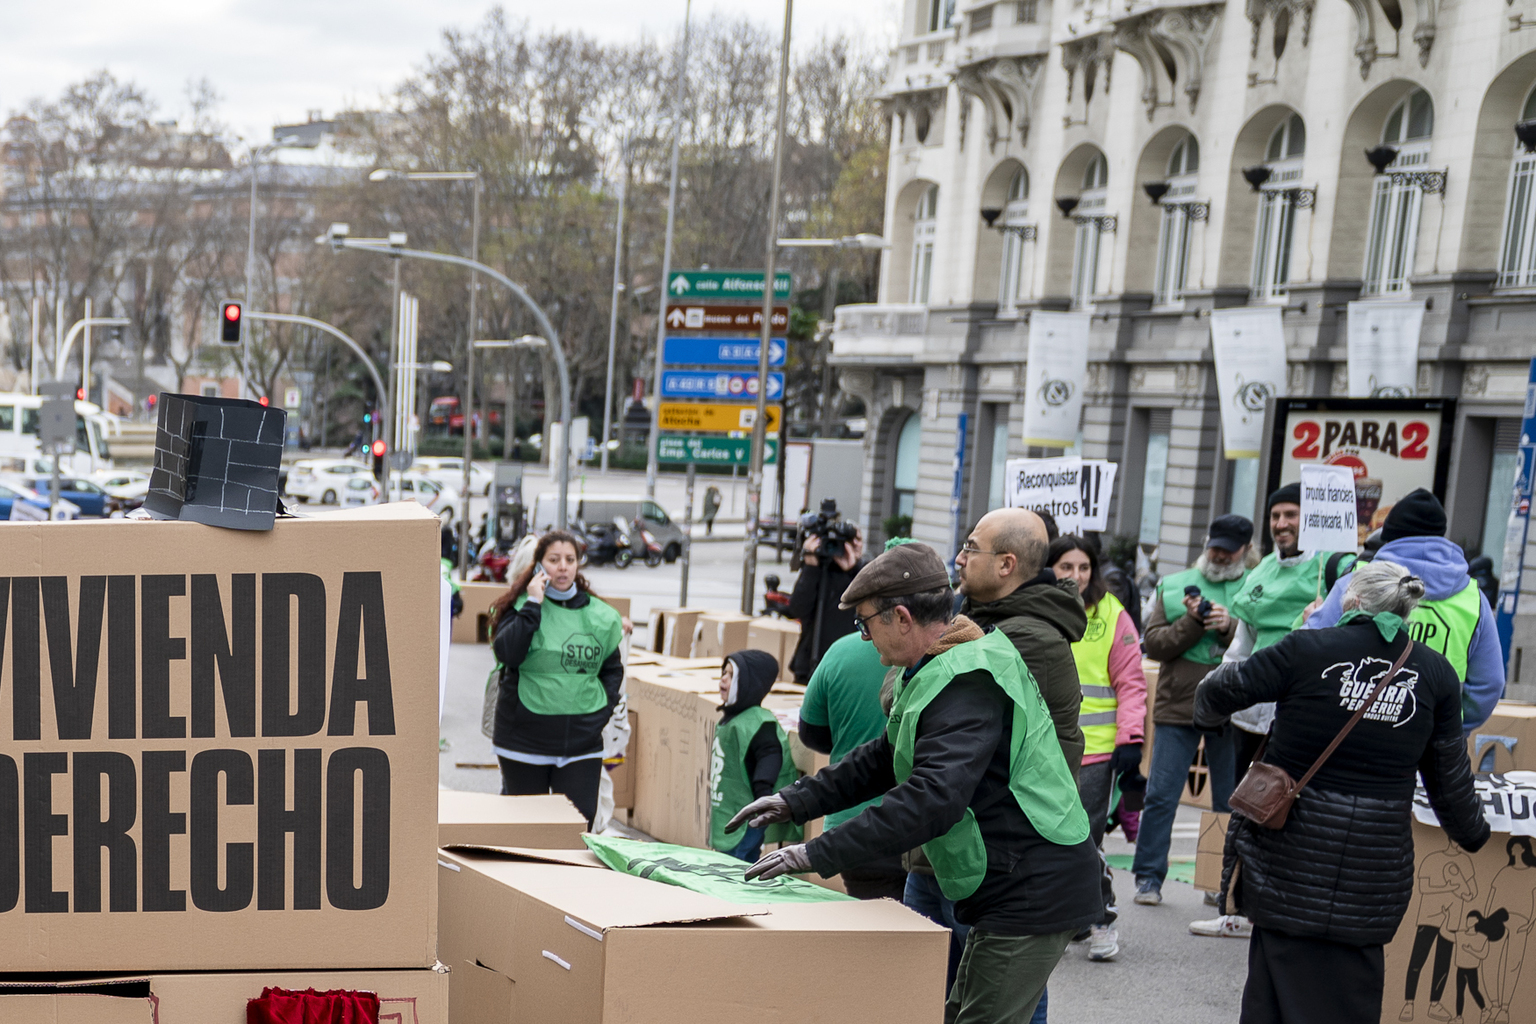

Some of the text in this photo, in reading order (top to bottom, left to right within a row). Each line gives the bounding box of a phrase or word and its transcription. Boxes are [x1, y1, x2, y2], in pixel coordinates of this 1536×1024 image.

[1292, 420, 1321, 460] 2
[1322, 420, 1400, 460] PARA
[1400, 420, 1430, 461] 2
[1017, 499, 1079, 517] uestros
[567, 644, 601, 661] STOP
[1339, 698, 1403, 716] CERERUS
